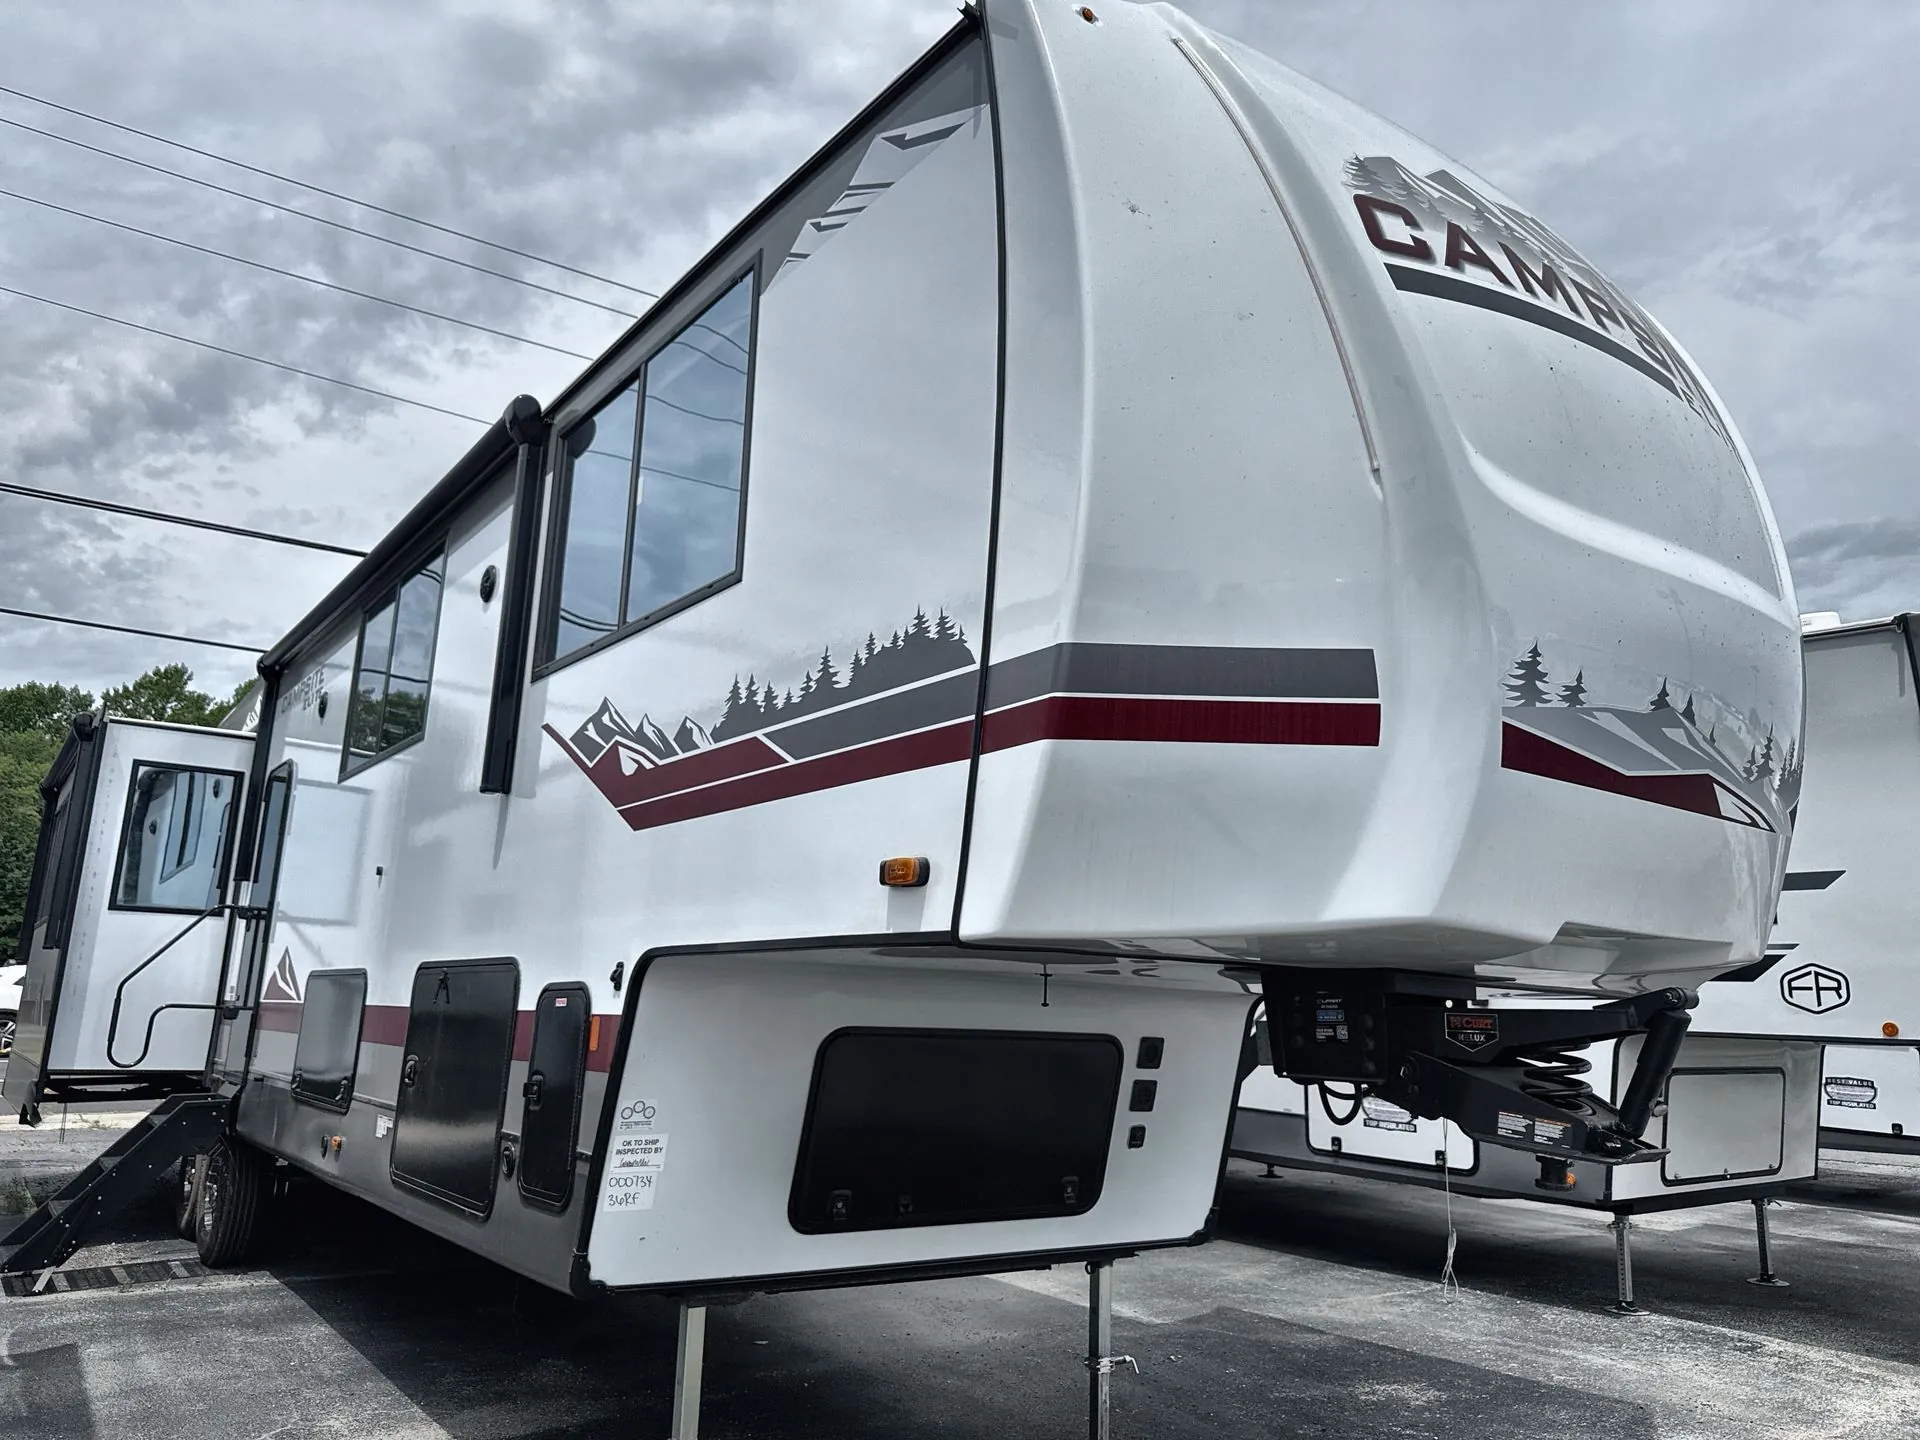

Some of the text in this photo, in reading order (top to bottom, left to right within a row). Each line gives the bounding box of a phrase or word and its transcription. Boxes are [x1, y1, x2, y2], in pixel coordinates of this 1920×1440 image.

[1788, 969, 1843, 1007] FR
[622, 1139, 633, 1147] OK
[644, 1138, 660, 1146] SHIP
[615, 1146, 664, 1156] INSPECTED BY
